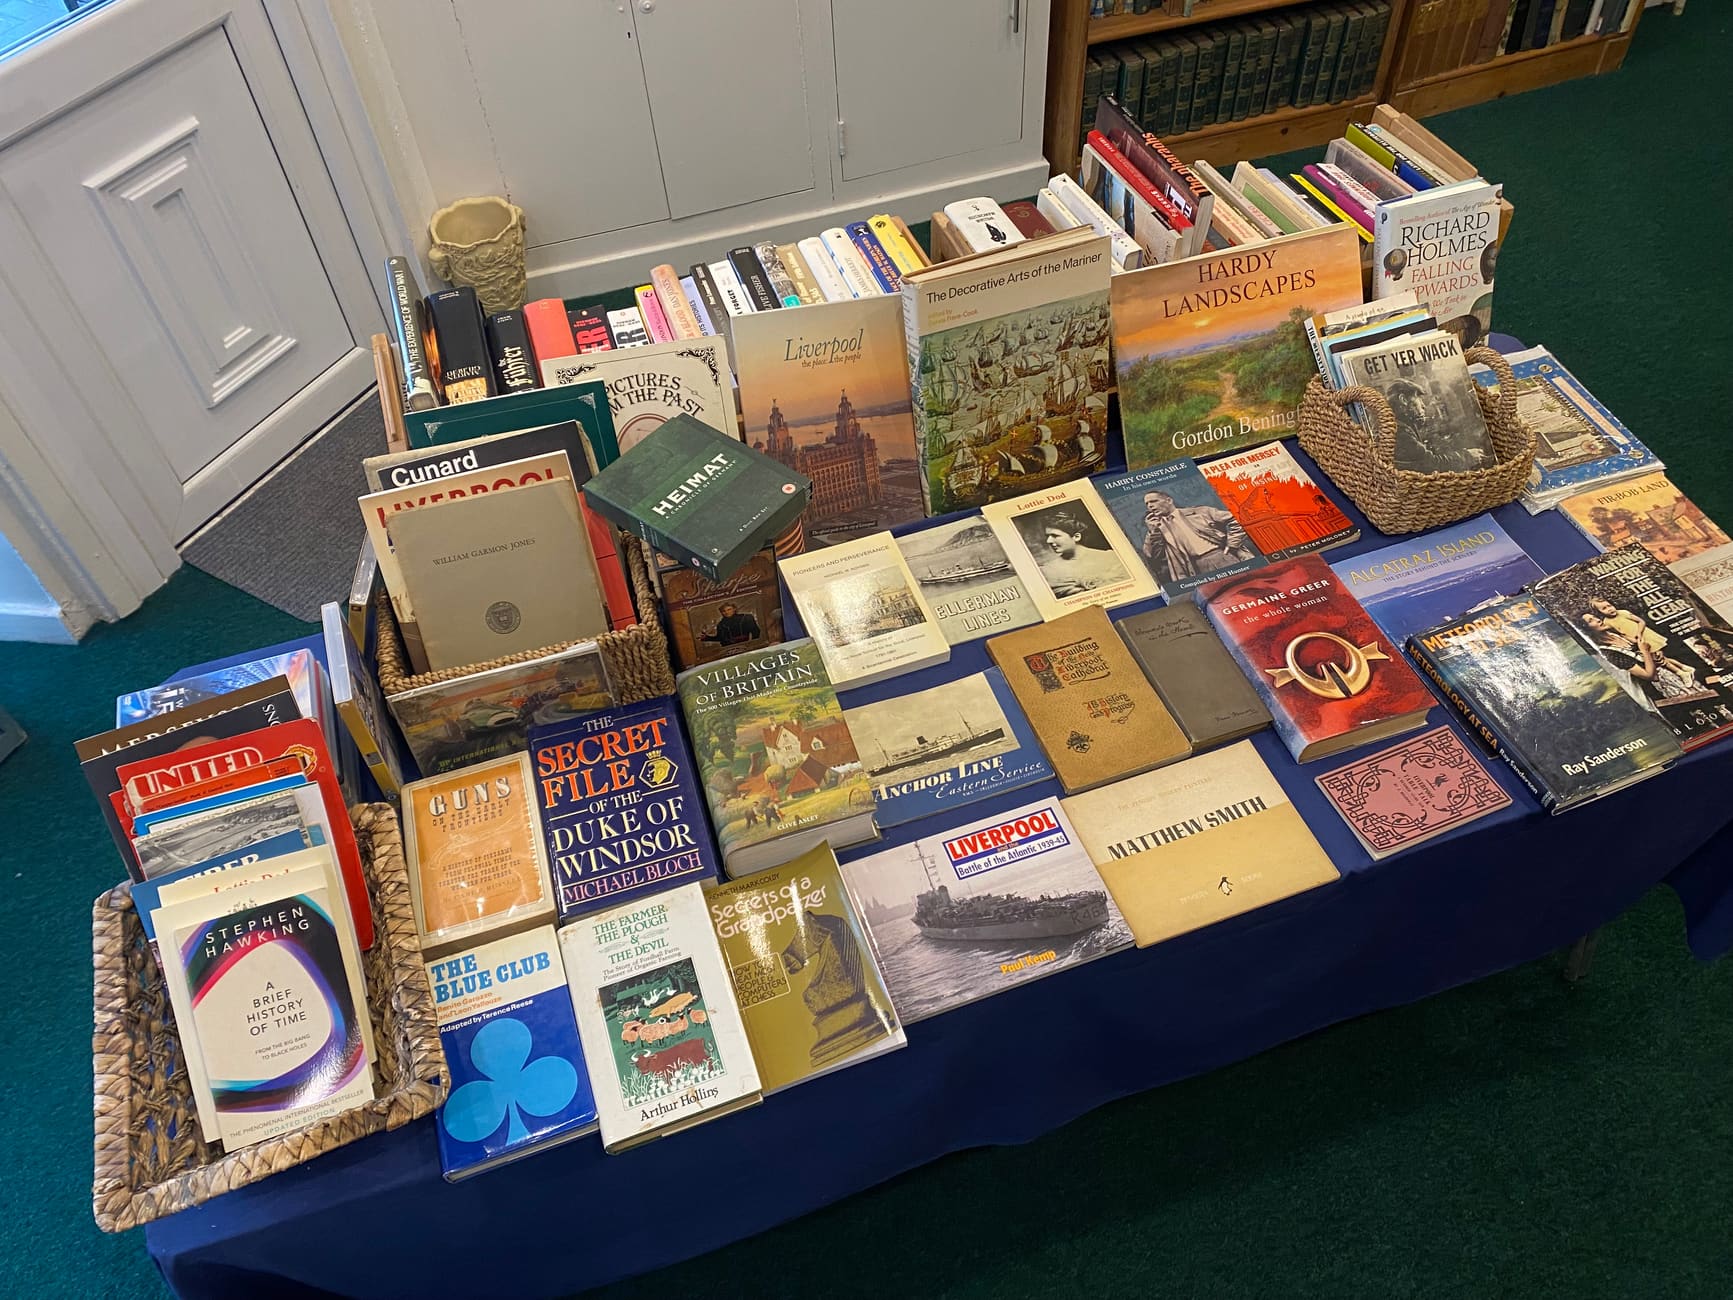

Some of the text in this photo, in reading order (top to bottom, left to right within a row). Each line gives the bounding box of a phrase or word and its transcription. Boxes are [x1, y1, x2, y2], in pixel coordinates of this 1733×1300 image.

[1142, 132, 1191, 178] pharaohs
[1401, 212, 1490, 249] RICHARD
[1407, 231, 1487, 267] HOLMES
[927, 252, 1102, 304] The Decorative Arts of the Mariner
[1198, 250, 1277, 283] HARDY
[1411, 257, 1474, 283] FALLING
[396, 285, 410, 305] WORLD
[727, 289, 741, 311] FORGET
[1163, 269, 1316, 318] LANDSCAPES
[1405, 273, 1479, 297] PWARDS
[402, 314, 417, 350] EXPERIENCE
[784, 329, 864, 363] Liverpool
[408, 348, 418, 361] THE
[1308, 327, 1330, 385] THE MERSEYSIDE
[1364, 339, 1458, 375] GET YER WACK
[603, 373, 682, 401] PICTURES
[624, 387, 705, 417] THE PAST
[1172, 404, 1303, 450] Gordon Beningf
[390, 451, 479, 489] Cunard
[1104, 463, 1187, 491] HARRY CONSTABLE
[1204, 447, 1280, 475] A PLEA FOR MERSEY
[651, 453, 731, 516] HEIMAT
[671, 489, 702, 515] CHRONICLE
[712, 459, 736, 481] GERMANY
[1597, 480, 1670, 505] FIR-BOB LAND
[1017, 492, 1066, 511] Lottie Dod
[432, 537, 536, 567] WILLIAM GARMON JONES
[792, 564, 824, 577] PIONEERS
[825, 558, 840, 568] AND
[840, 544, 889, 564] PERSEVERANCE
[1350, 531, 1496, 585] ALCATRAZ ISLAND
[1589, 550, 1647, 577] WAITING
[1180, 575, 1207, 589] Compiled
[1215, 570, 1227, 579] Bill
[1227, 565, 1250, 577] Hunter
[1615, 566, 1646, 584] FOR
[1626, 578, 1657, 595] THE
[937, 586, 1021, 619] ELLERMAN
[1064, 596, 1092, 606] CHAMPION
[1100, 584, 1135, 597] CHAMPIONS
[1222, 580, 1330, 615] GERMAINE GREER
[1244, 596, 1328, 624] the whole woman
[1642, 591, 1669, 607] ALL
[1648, 599, 1692, 621] CLEAR
[965, 608, 1010, 633] LINES
[1060, 641, 1099, 659] Building
[698, 650, 800, 686] VILLAGES
[1062, 662, 1109, 681] Cathedral
[696, 663, 812, 706] OF BRITAIN
[1410, 645, 1498, 749] METEOROLOGY AT SEA
[583, 716, 614, 733] THE
[537, 717, 668, 777] SECRET
[1562, 736, 1648, 777] Ray Sanderson
[541, 760, 635, 808] FILE
[875, 772, 953, 802] ANCHOR
[958, 755, 1003, 779] LINE
[929, 779, 988, 799] Eastern
[991, 760, 1042, 782] Service
[429, 777, 511, 816] GUNS
[588, 790, 642, 814] OF THE
[552, 796, 684, 852] DUKE OF
[777, 821, 797, 831] CLIVE
[948, 811, 1056, 860] LIVERPOOL
[1107, 796, 1267, 861] MATTHEW SMITH
[556, 824, 696, 880] WINDSOR
[958, 835, 1065, 876] Battle of the Atlantic 1939-45
[563, 851, 702, 902] MICHAEL BLOCH
[712, 891, 778, 921] Secrets
[801, 877, 812, 889] a
[205, 907, 303, 944] STEPHEN
[205, 919, 309, 959] HAWKING
[592, 922, 617, 935] THE
[596, 914, 668, 945] THE PLOUGH
[631, 934, 640, 944] &
[608, 938, 668, 965] THE DEVIL
[1000, 950, 1056, 975] Paul Kemp
[431, 954, 477, 982] THE
[434, 952, 550, 1003] BLUE CLUB
[252, 989, 292, 1008] BRIEF
[265, 981, 274, 991] A
[247, 999, 304, 1024] HISTORY
[250, 1012, 307, 1036] OF TIME
[440, 999, 533, 1033] Adapted by Terence Reese
[255, 1034, 310, 1055] FROM THE BIG BANG
[269, 1048, 287, 1059] BLACK
[289, 1043, 307, 1054] HOLES
[641, 1087, 718, 1121] Arthur Hollins
[263, 1108, 335, 1137] UPDATED EDITION
